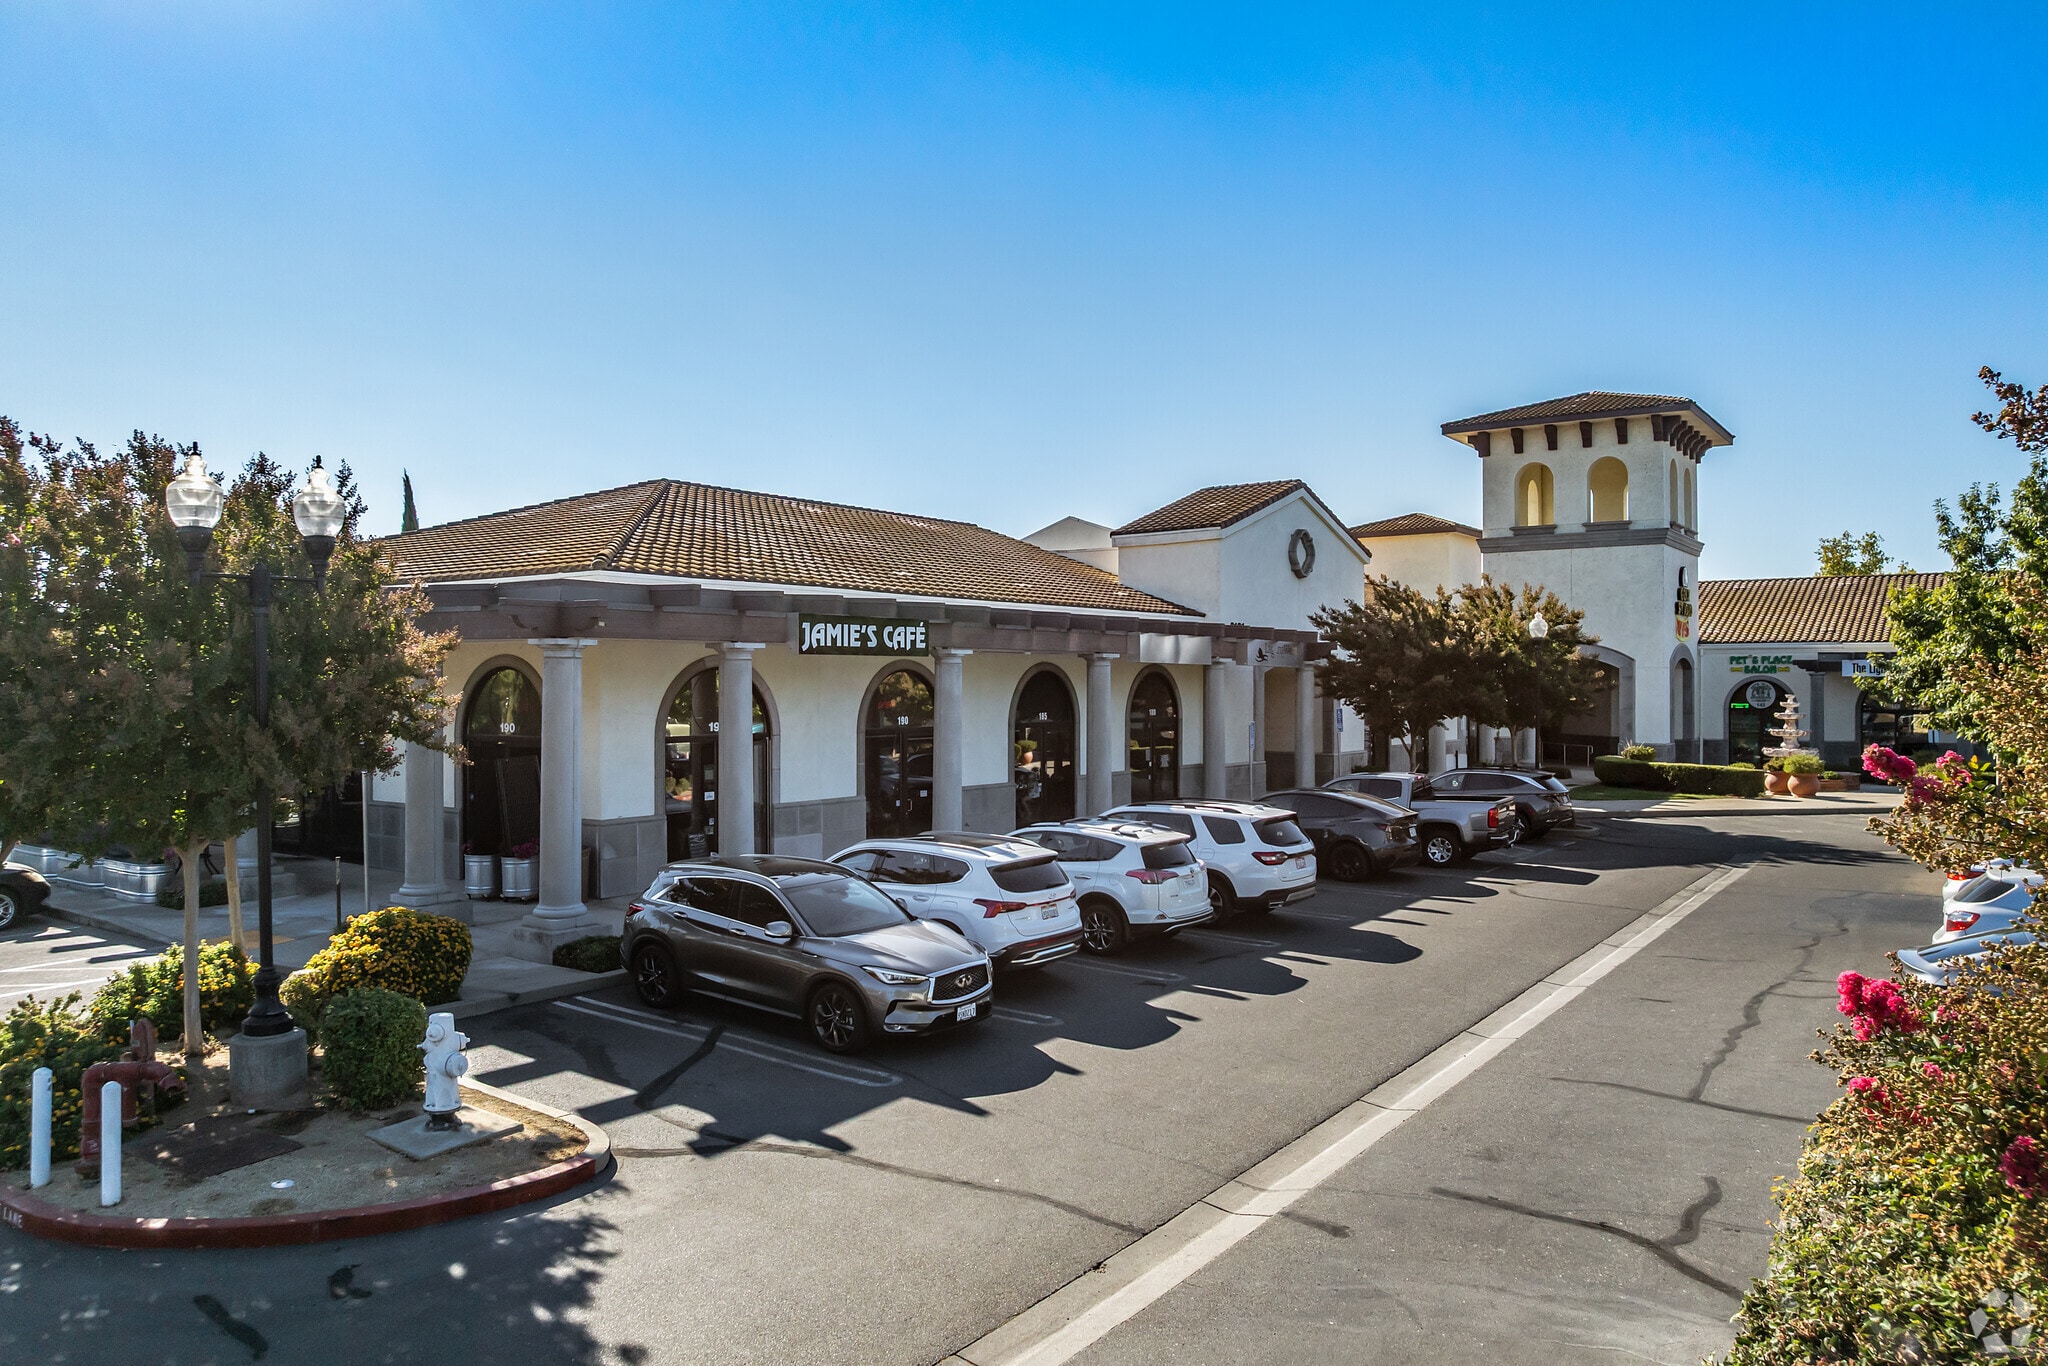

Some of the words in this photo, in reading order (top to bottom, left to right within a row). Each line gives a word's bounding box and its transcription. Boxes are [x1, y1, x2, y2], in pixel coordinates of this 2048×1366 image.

[801, 622, 878, 652] JAMIE'S
[883, 621, 927, 651] CAFÉ
[1729, 654, 1759, 665] PET'S
[1761, 655, 1793, 665] PLACE
[1744, 665, 1777, 674] SALON
[1852, 663, 1867, 674] The
[897, 715, 909, 725] 190
[500, 722, 516, 733] 190
[708, 721, 720, 732] 19
